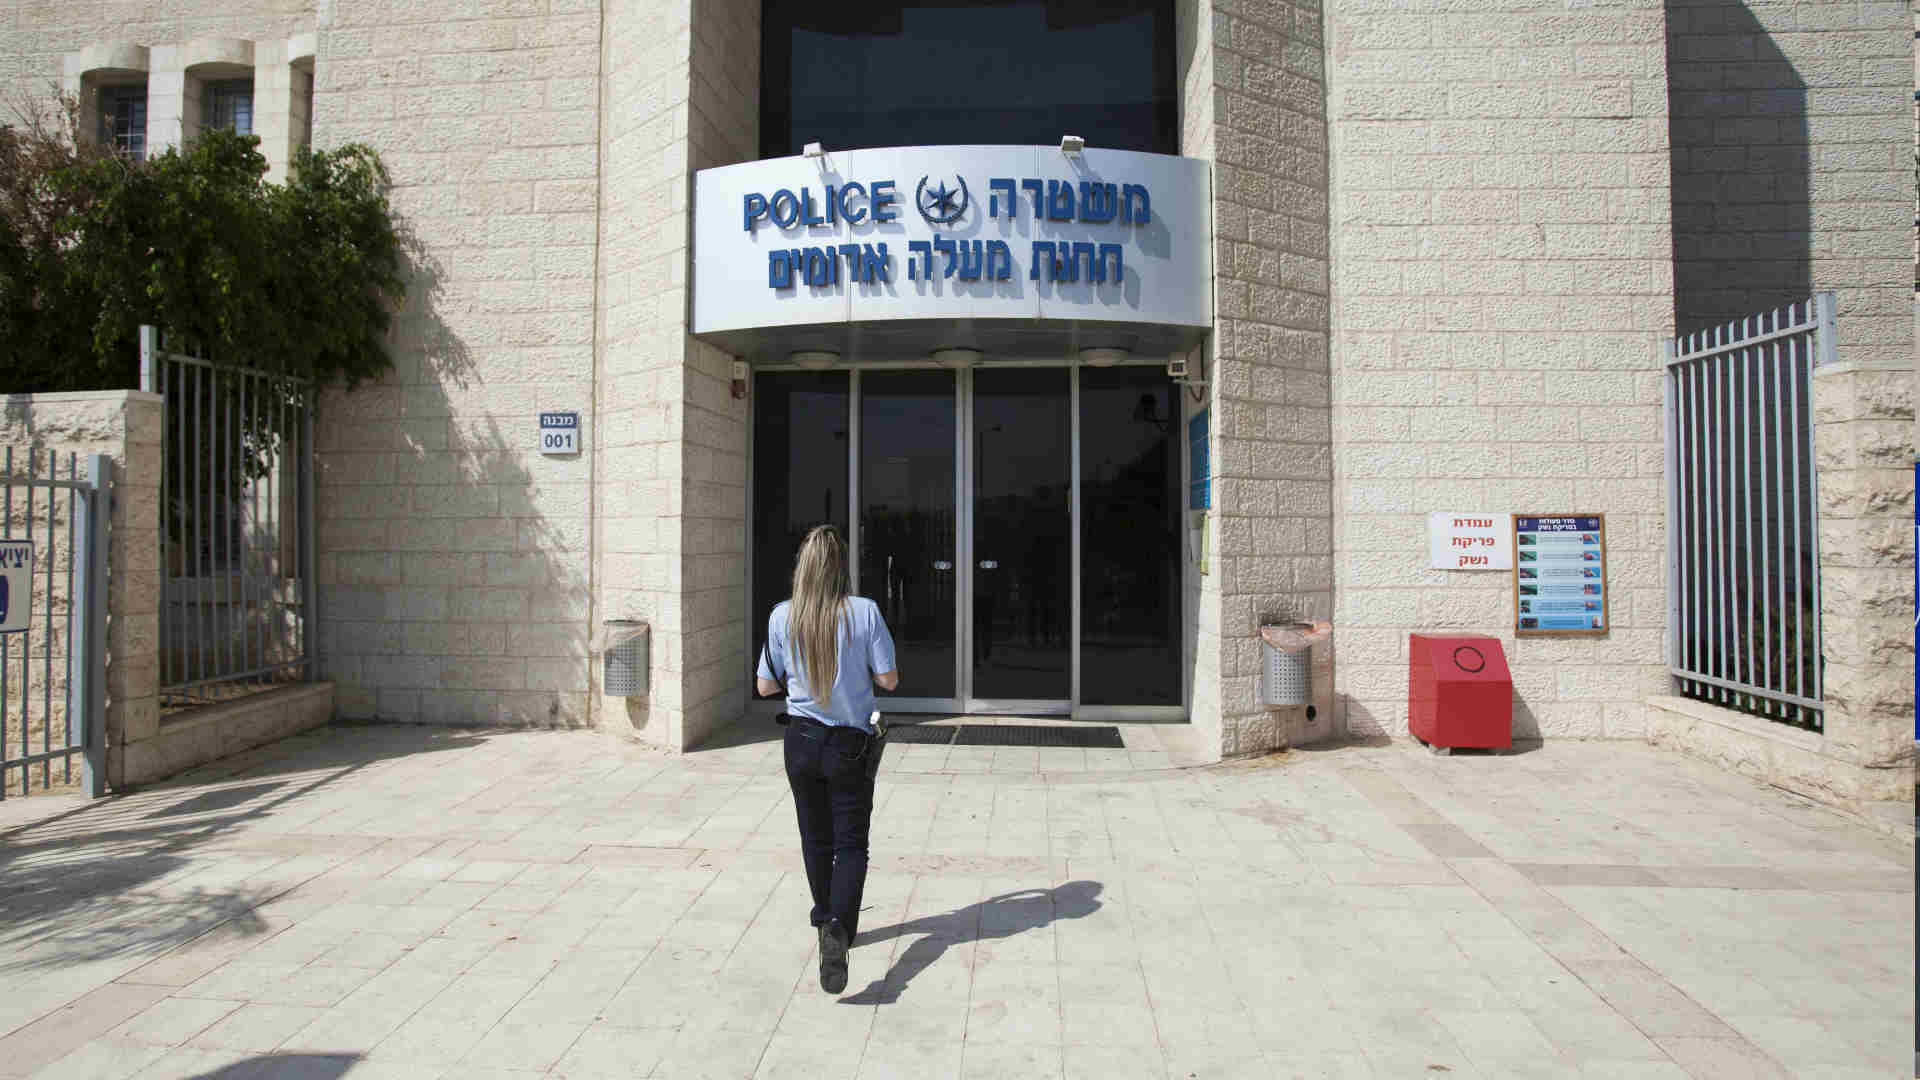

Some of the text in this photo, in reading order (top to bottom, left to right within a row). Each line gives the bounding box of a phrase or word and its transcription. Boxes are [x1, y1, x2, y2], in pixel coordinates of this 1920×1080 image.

[743, 179, 896, 231] POLICE
[989, 177, 1152, 224] משטרה
[768, 234, 1123, 289] תחנת מעלה אדומים
[543, 415, 574, 425] מבנה
[545, 434, 571, 448] 001
[1453, 518, 1493, 528] עמדת
[1452, 536, 1495, 549] פריקת
[1459, 555, 1489, 567] נשק
